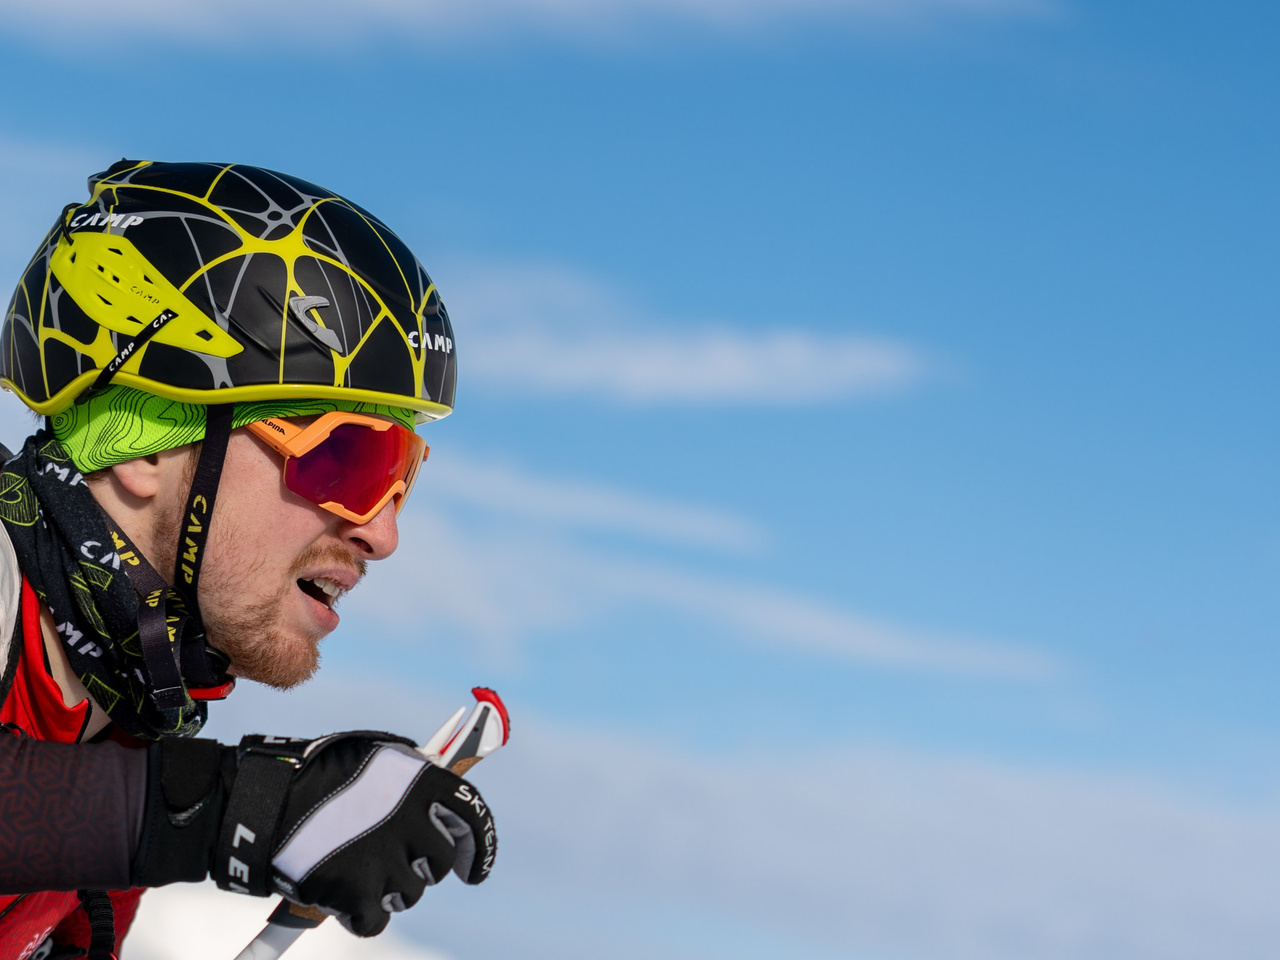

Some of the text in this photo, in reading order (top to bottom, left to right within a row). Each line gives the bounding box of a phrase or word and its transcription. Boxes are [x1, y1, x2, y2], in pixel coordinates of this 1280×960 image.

[70, 212, 144, 229] CAMP
[130, 285, 160, 304] CAMP
[152, 313, 173, 328] CA
[108, 341, 135, 372] CAMP
[408, 330, 453, 354] CAMP
[110, 531, 140, 566] MP
[184, 494, 207, 584] CAMP
[80, 540, 121, 570] CA
[454, 784, 495, 875] SKI TEAM
